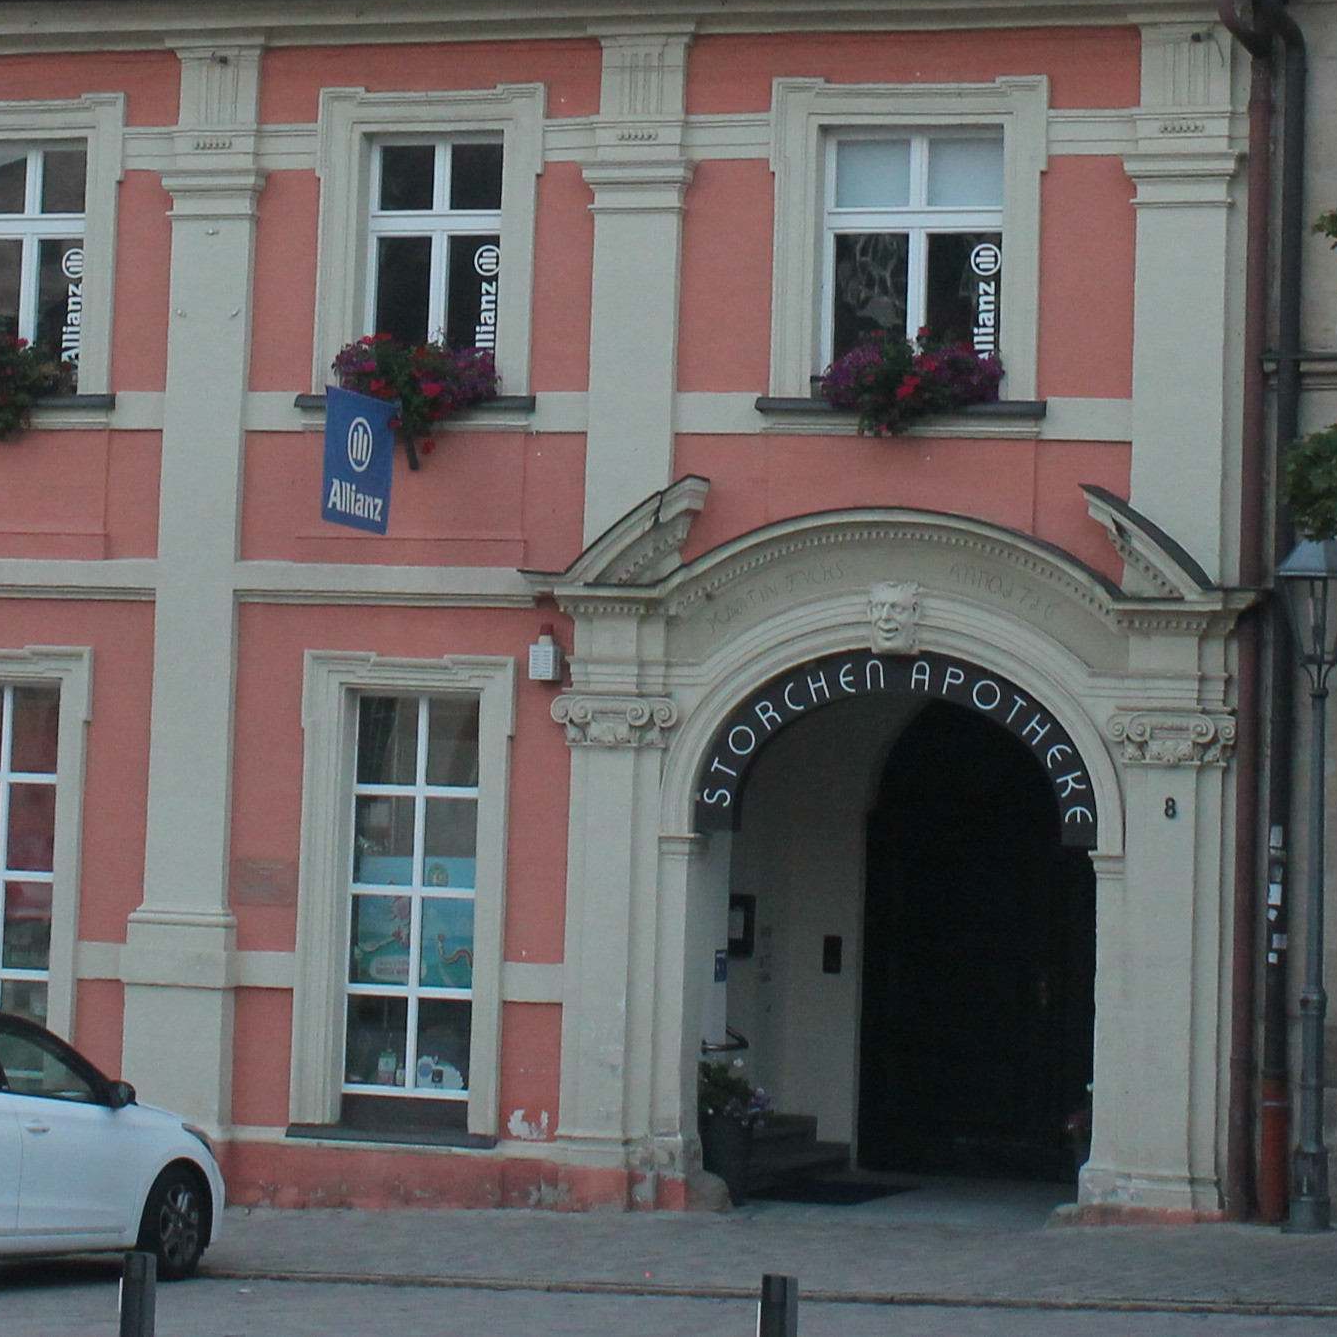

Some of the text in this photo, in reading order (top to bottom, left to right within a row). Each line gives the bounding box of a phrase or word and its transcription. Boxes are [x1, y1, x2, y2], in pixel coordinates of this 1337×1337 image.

[474, 281, 496, 349] llianz
[327, 478, 383, 522] Allianz
[703, 659, 1094, 825] STORCHEN APOTHEKE
[1164, 797, 1177, 820] 8
